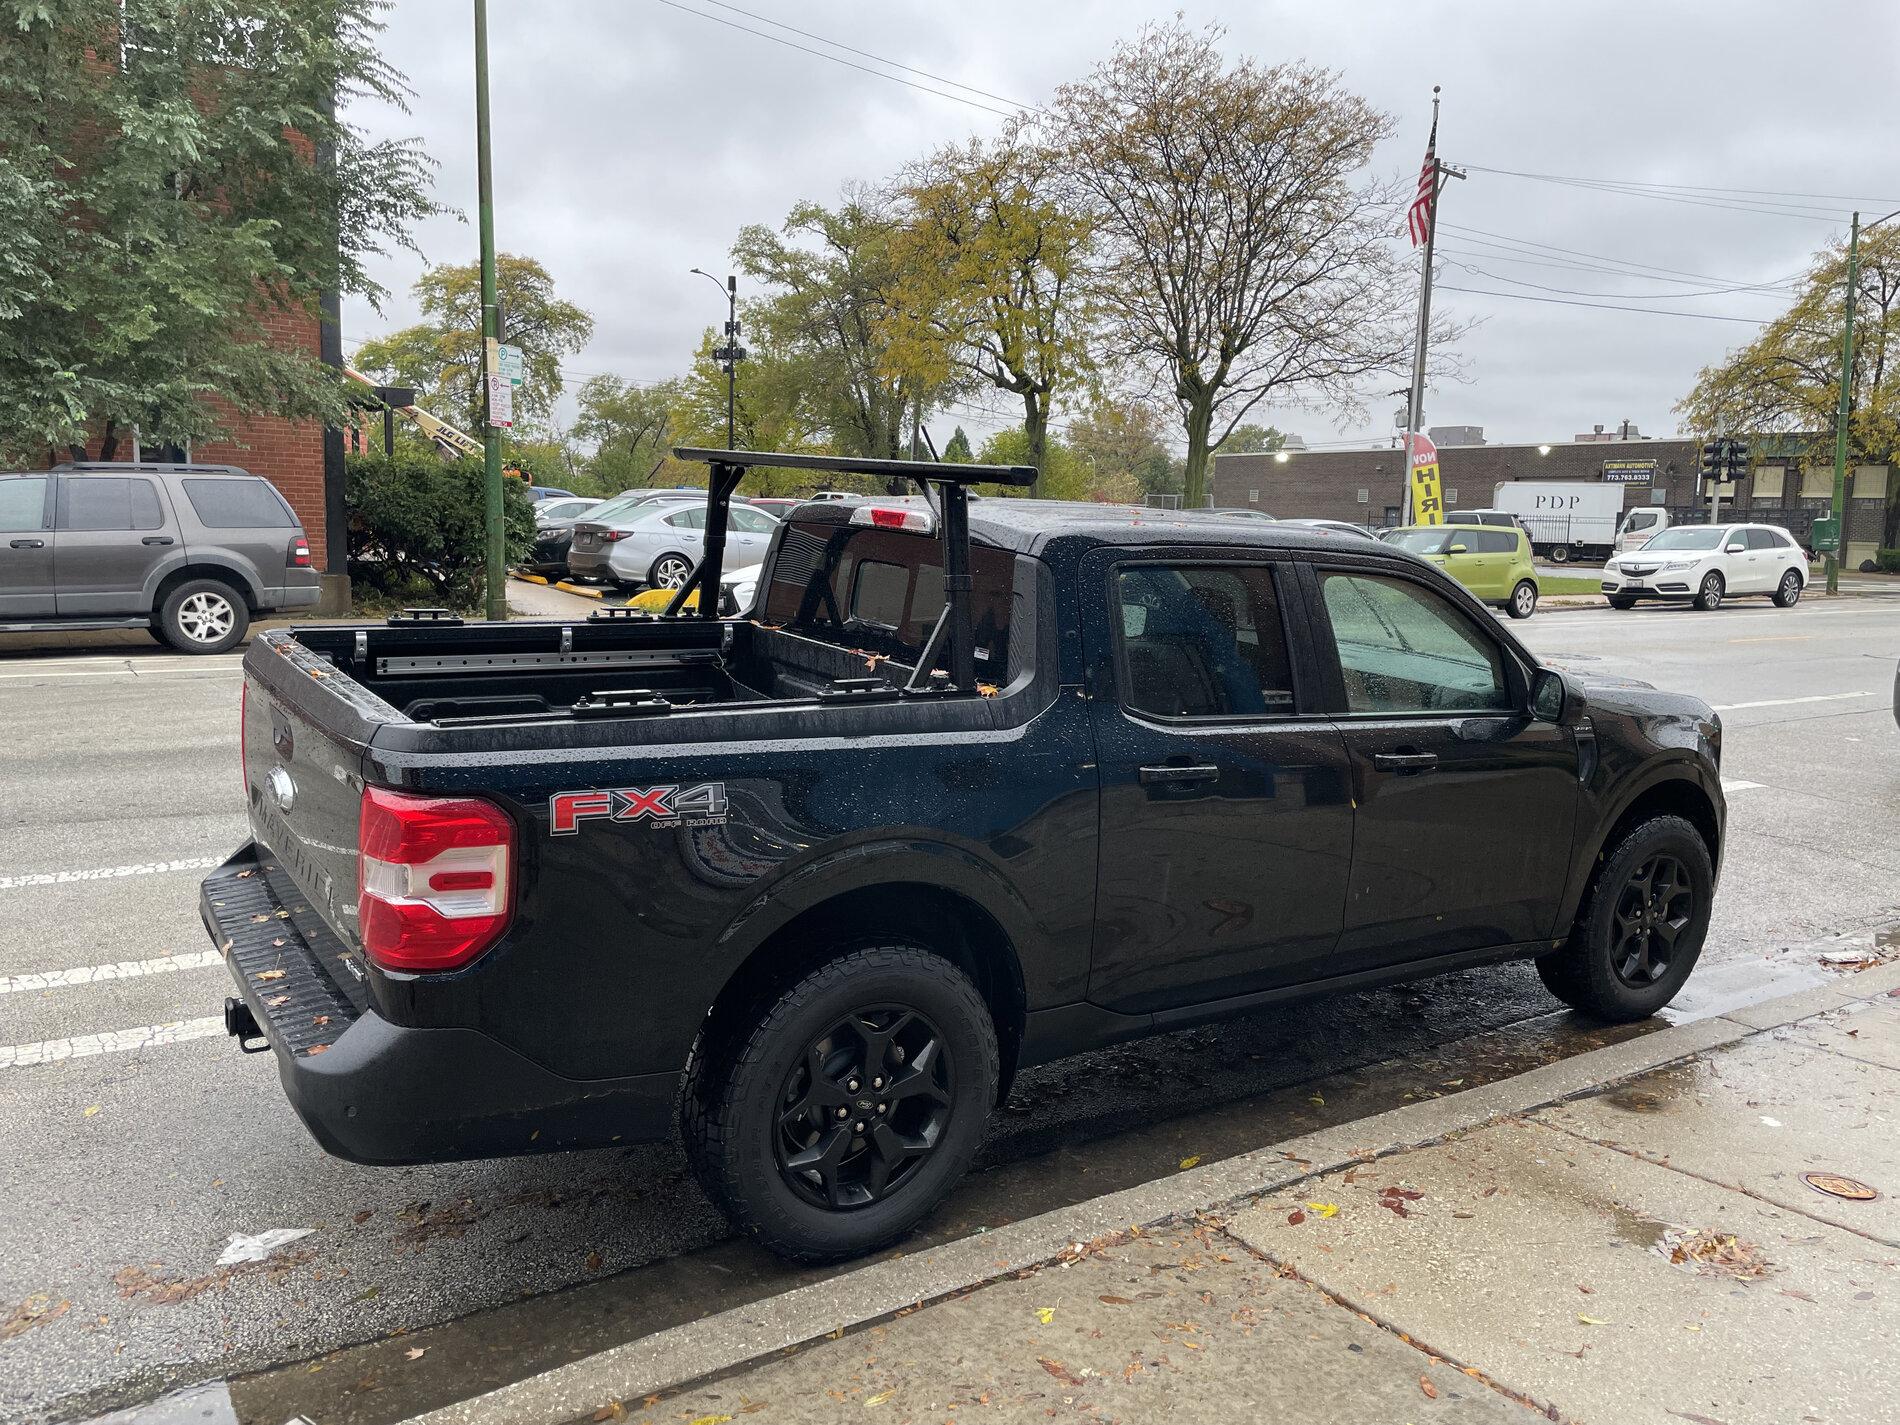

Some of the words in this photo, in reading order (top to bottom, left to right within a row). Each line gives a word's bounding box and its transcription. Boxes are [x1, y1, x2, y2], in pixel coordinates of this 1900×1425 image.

[436, 426, 455, 438] JLG
[1536, 496, 1580, 509] PDP
[550, 782, 728, 836] FX4
[650, 819, 682, 829] OFF
[686, 817, 727, 827] ROAD
